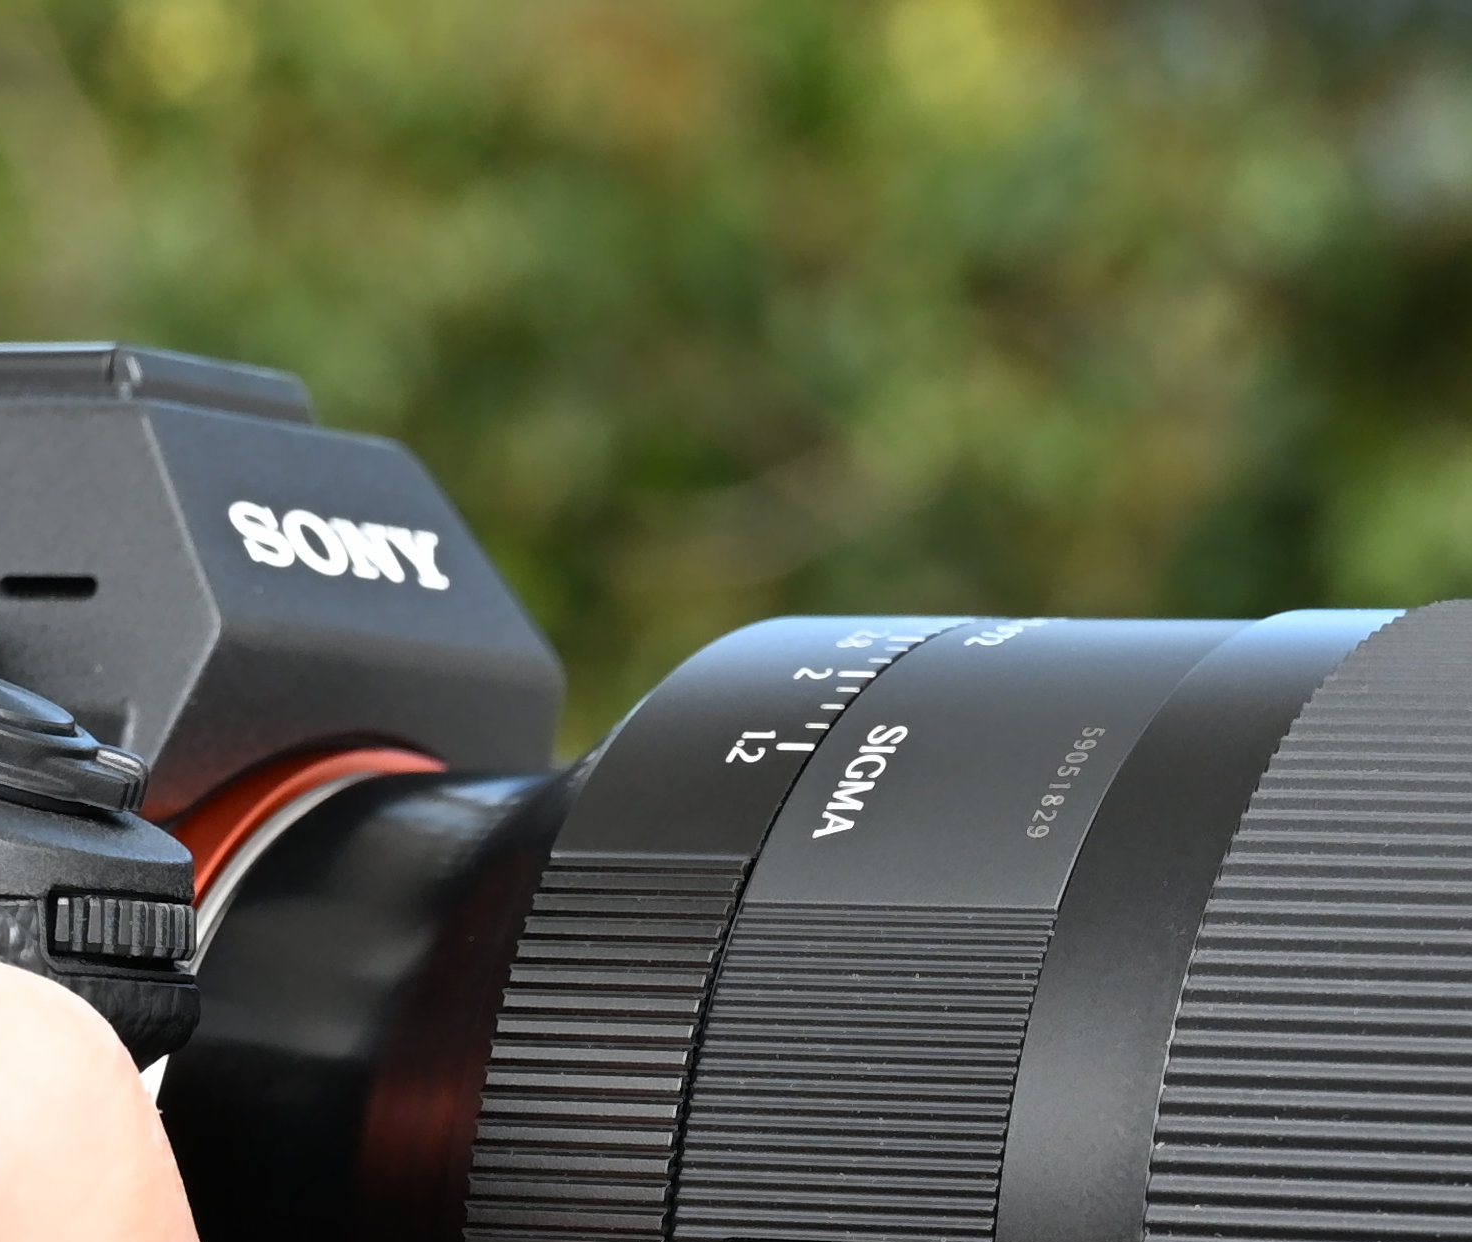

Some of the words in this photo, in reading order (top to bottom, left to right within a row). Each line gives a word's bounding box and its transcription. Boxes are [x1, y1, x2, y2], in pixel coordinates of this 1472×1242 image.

[228, 501, 450, 590] SONY
[725, 729, 777, 764] 1.2
[812, 724, 908, 839] SIGMA
[1026, 726, 1106, 838] 59051829
